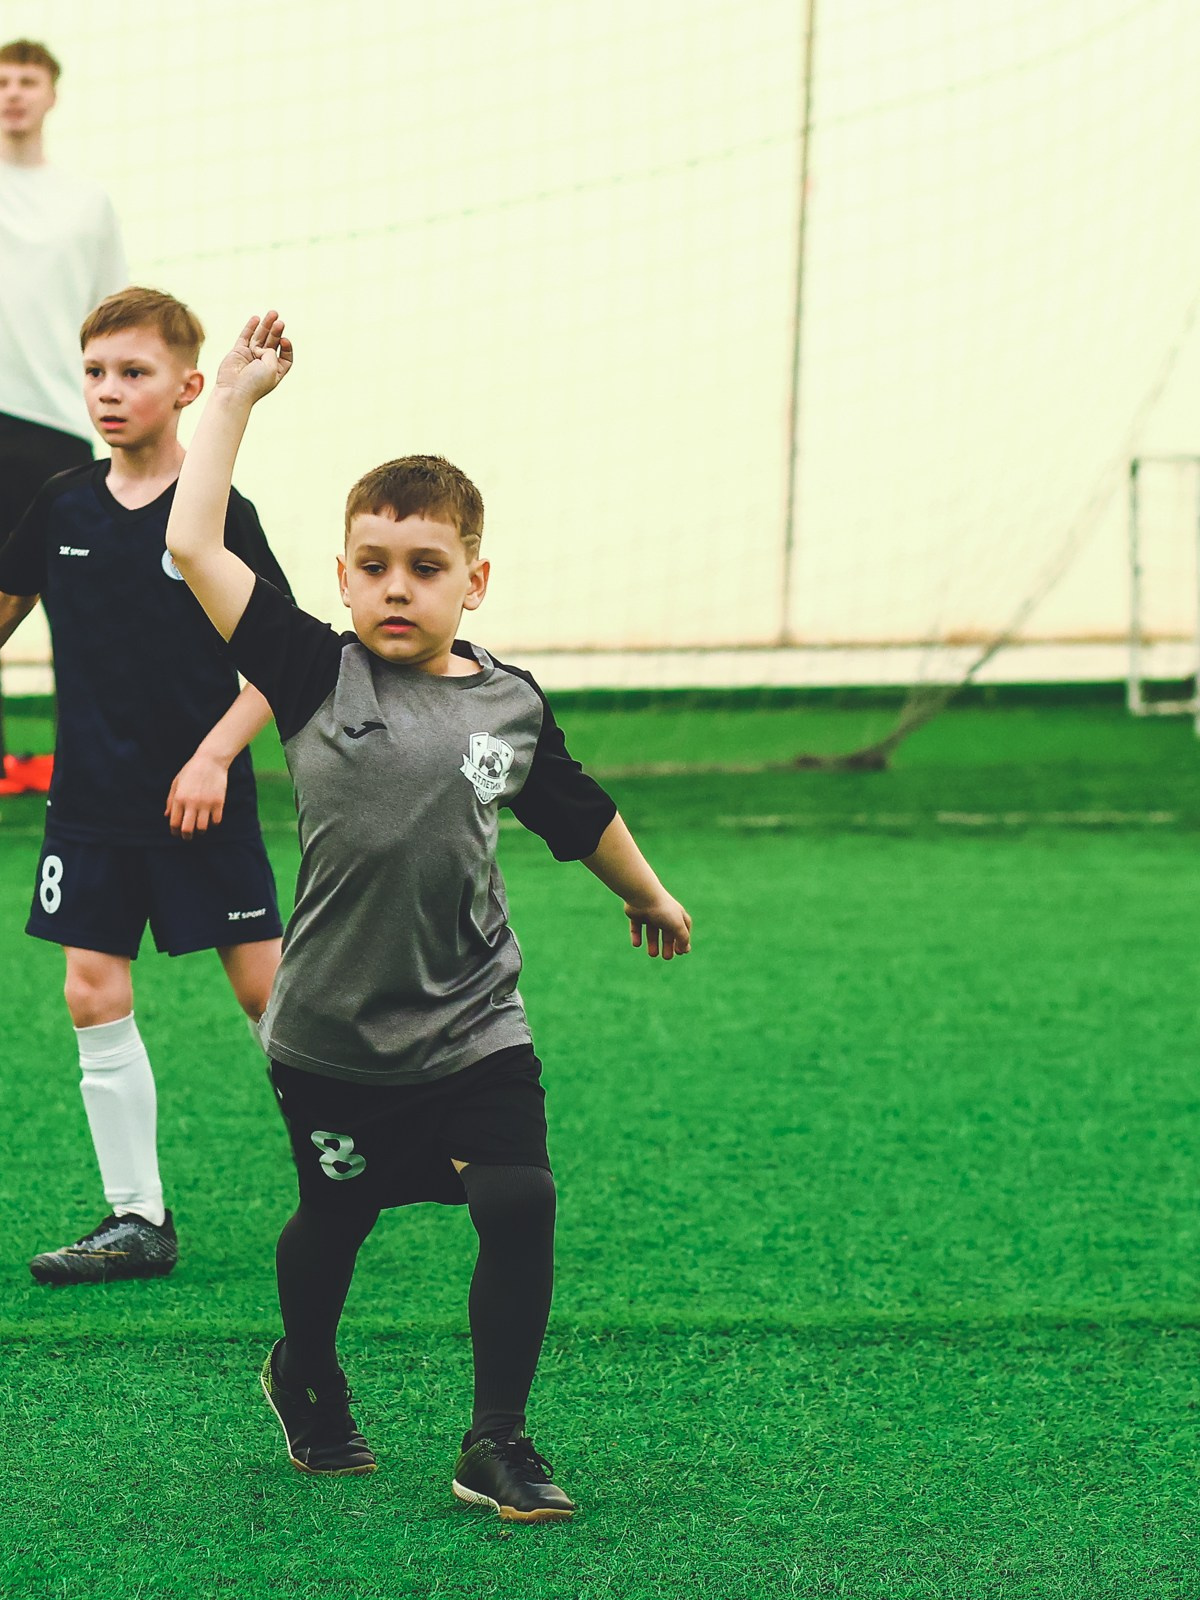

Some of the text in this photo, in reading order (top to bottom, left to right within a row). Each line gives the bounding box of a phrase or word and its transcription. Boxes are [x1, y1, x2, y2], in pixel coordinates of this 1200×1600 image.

[70, 547, 90, 557] SPORT
[39, 854, 64, 914] 8
[241, 907, 266, 919] SPORT
[310, 1130, 367, 1181] 8
